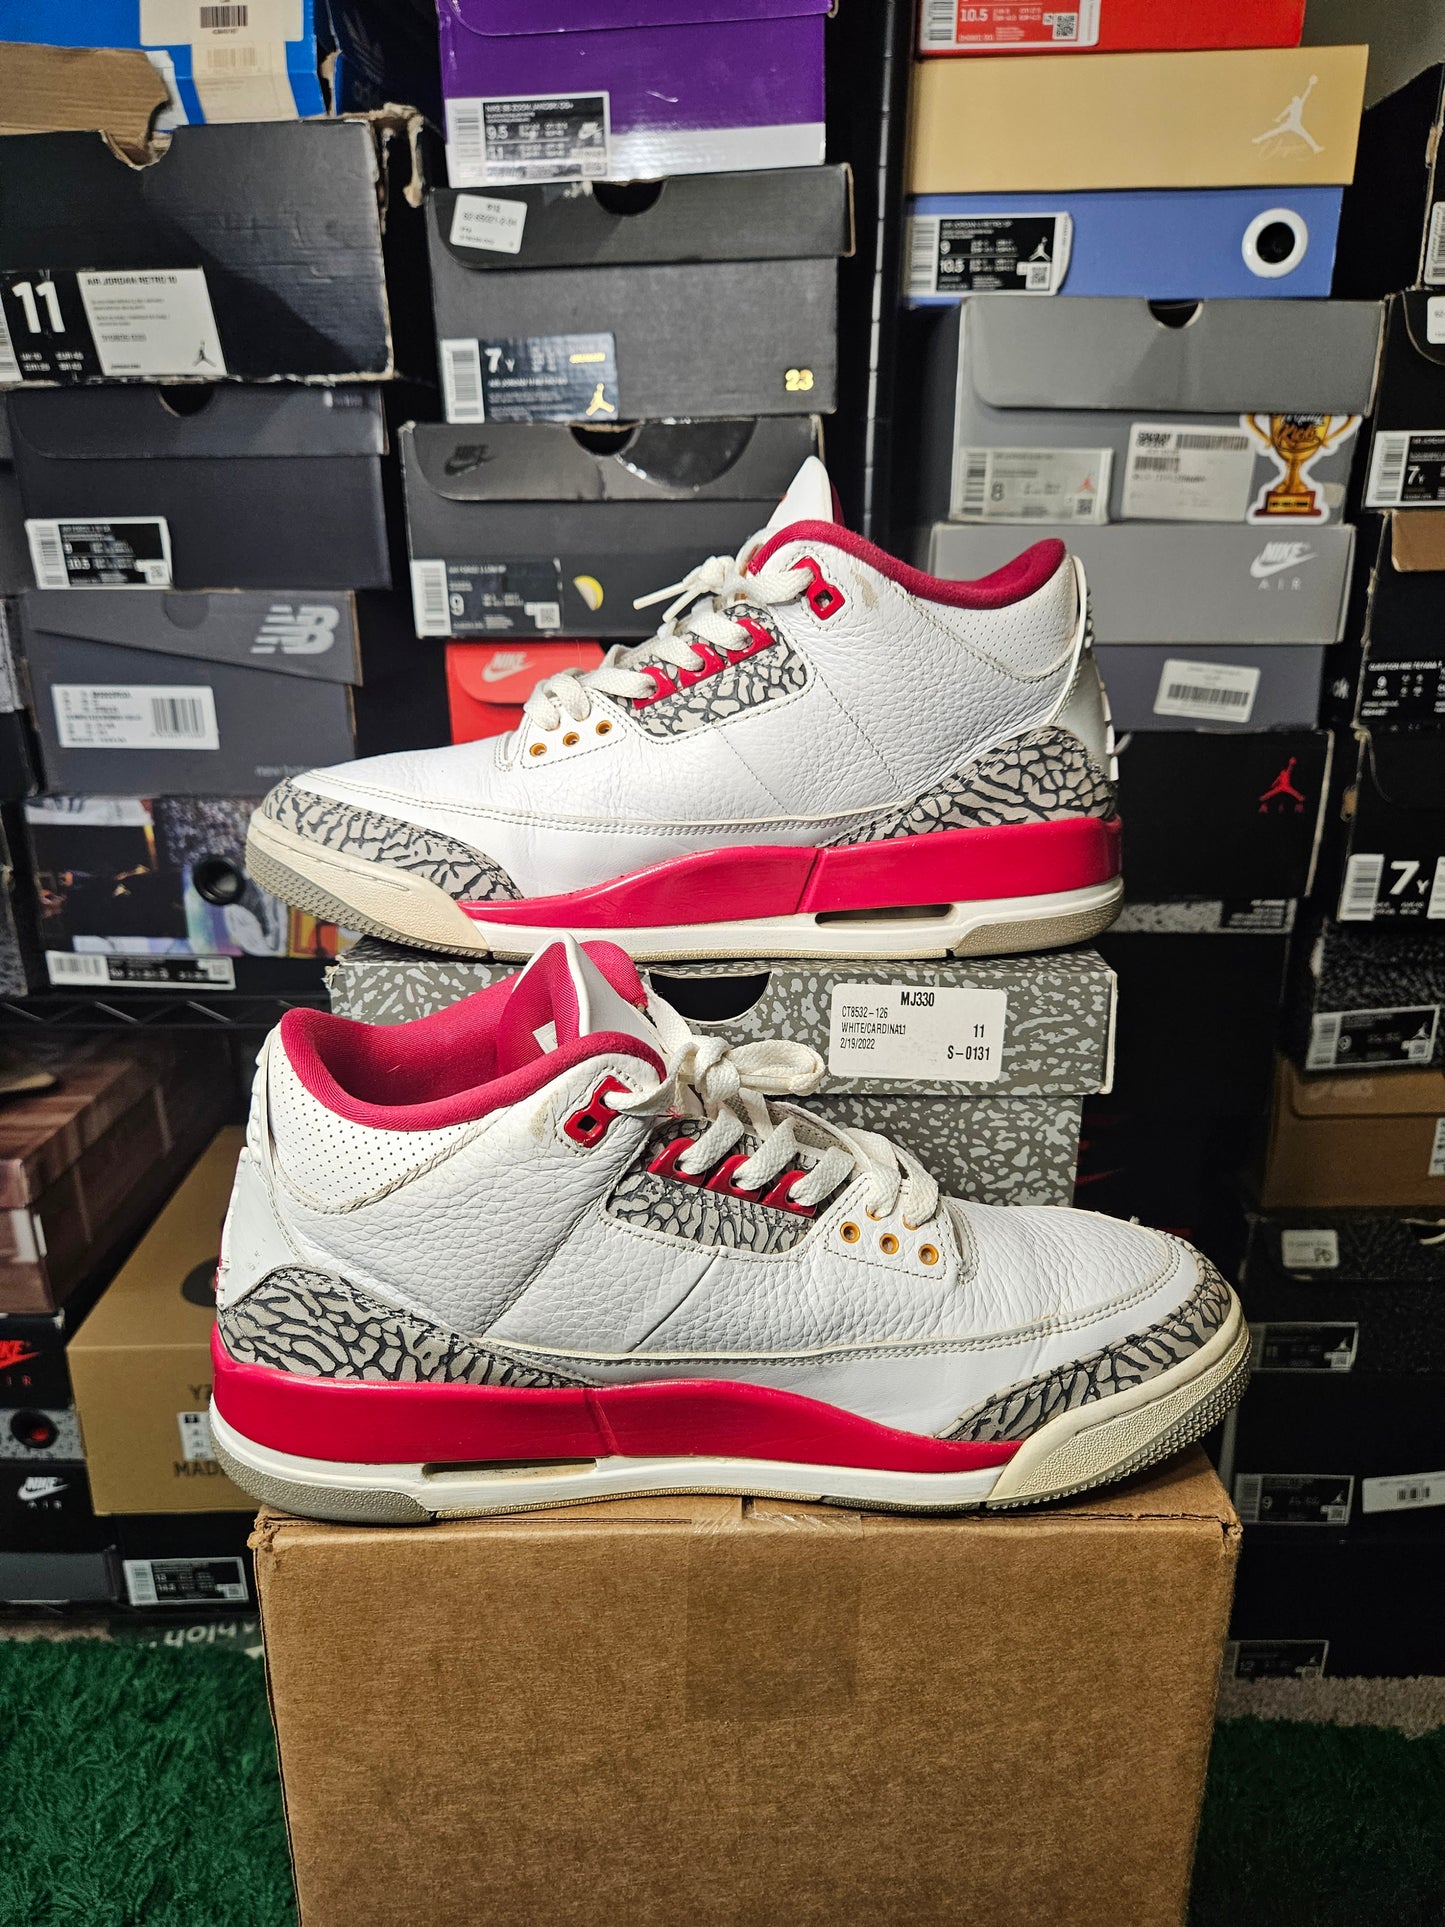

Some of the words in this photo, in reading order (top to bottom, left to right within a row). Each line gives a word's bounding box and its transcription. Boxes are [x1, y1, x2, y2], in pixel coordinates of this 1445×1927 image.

[960, 8, 988, 22] 10.5
[486, 124, 509, 140] 9.5
[940, 259, 965, 274] 10.5
[11, 281, 66, 333] 11
[785, 369, 814, 391] 23
[1260, 541, 1304, 563] NIKE
[1257, 577, 1302, 592] AIR
[450, 592, 465, 617] 9
[491, 651, 528, 671] NIKE
[900, 991, 935, 1007] MJ330
[841, 1006, 888, 1019] CT8532-126
[973, 1024, 985, 1038] 11
[840, 1037, 875, 1050] 2/19/2022
[947, 1045, 990, 1060] S-0131
[174, 1461, 224, 1477] MAD
